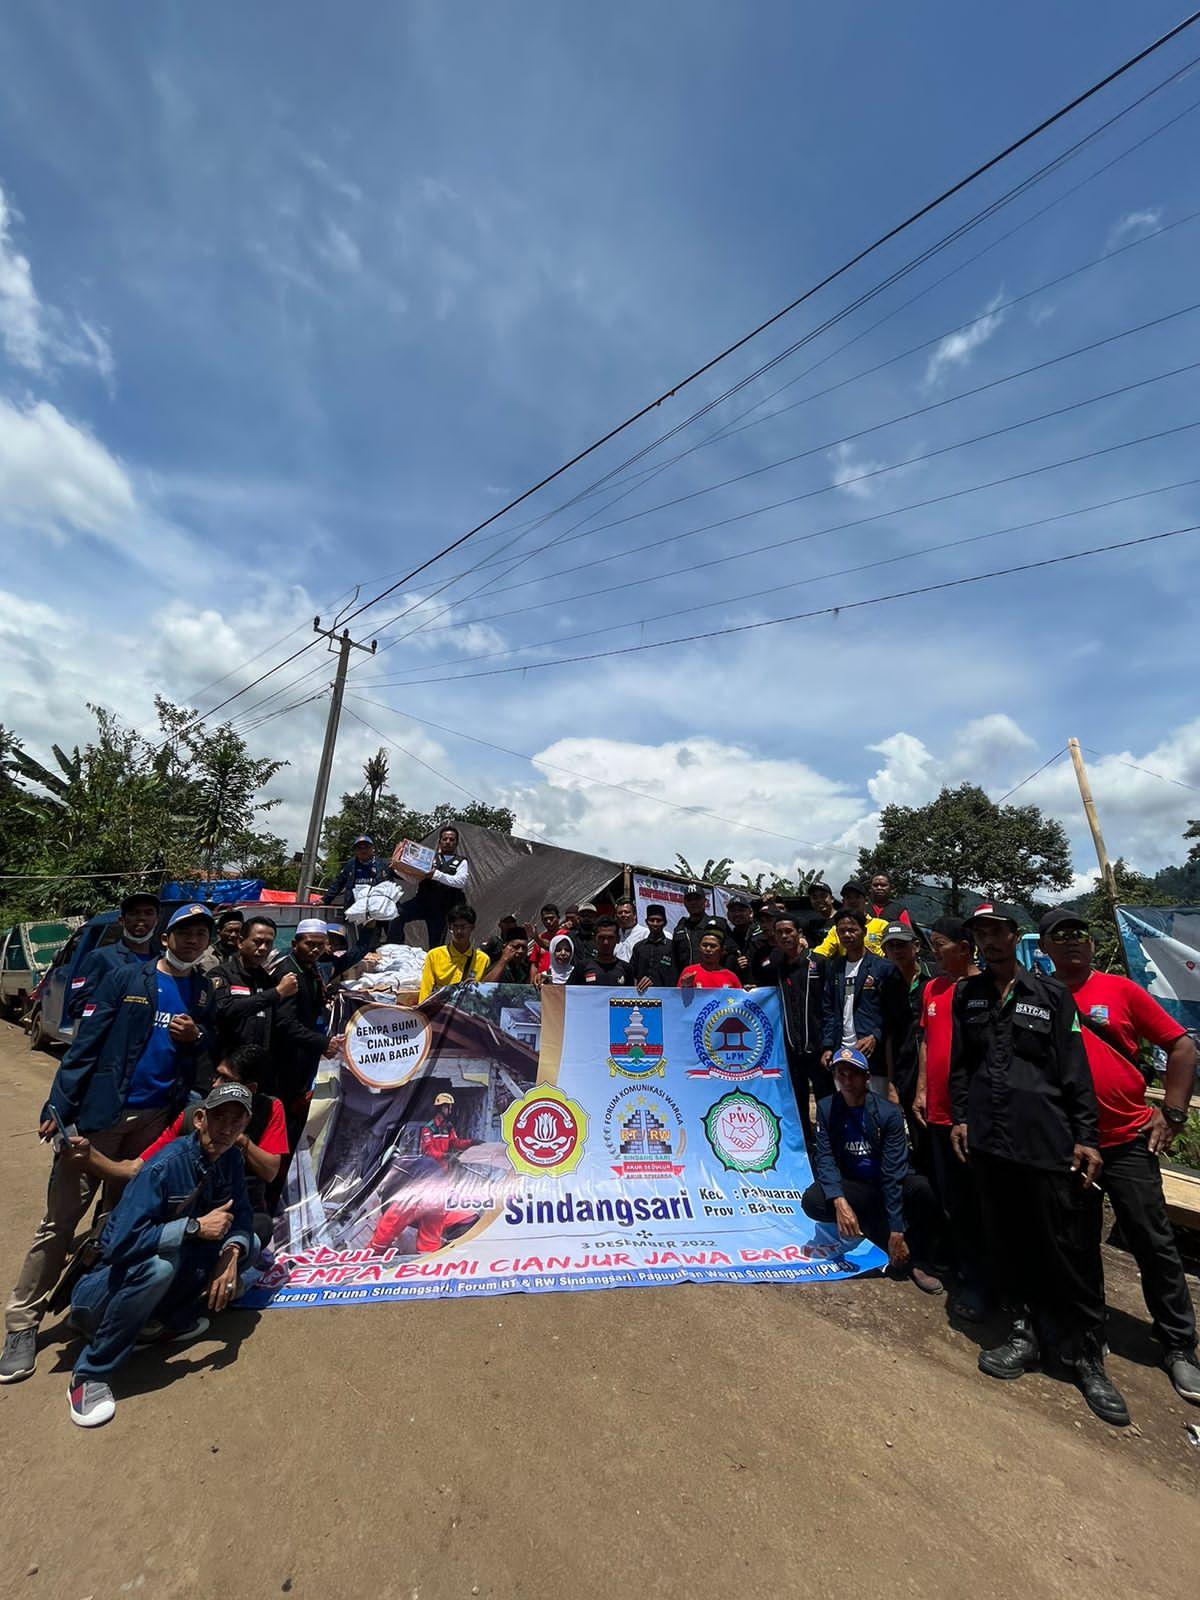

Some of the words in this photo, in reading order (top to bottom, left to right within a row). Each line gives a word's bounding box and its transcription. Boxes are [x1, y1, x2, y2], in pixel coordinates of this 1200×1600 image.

[356, 1024, 389, 1037] GEMPA
[392, 1018, 418, 1033] BUMI
[367, 1034, 409, 1050] CIANJUR
[358, 1051, 386, 1065] JAWA
[389, 1044, 420, 1061] BARAT
[605, 1096, 622, 1124] FORUM
[619, 1084, 665, 1098] KOMUNIKASI
[665, 1095, 684, 1126] WARGA
[729, 1112, 755, 1123] PWS
[620, 1128, 638, 1141] RT
[650, 1128, 671, 1141] RW
[741, 1187, 802, 1200] Pabuaran
[446, 1189, 494, 1209] Desa
[505, 1191, 693, 1227] Sindangsari
[704, 1205, 734, 1217] Prov
[394, 1260, 479, 1279] BUMI
[489, 1253, 637, 1272] CIANJUR
[644, 1250, 732, 1266] JAWA
[740, 1243, 841, 1263] BARAT
[269, 1293, 315, 1303] Karang
[322, 1290, 366, 1300] Taruna
[372, 1283, 453, 1297] Sindangsari,
[457, 1281, 496, 1292] Forum
[501, 1279, 517, 1289] RT
[521, 1279, 530, 1288] &
[535, 1277, 555, 1287] RW
[559, 1273, 635, 1286] Sindangsari,
[705, 1270, 744, 1280] Warga
[745, 1267, 815, 1280] Sindangsari
